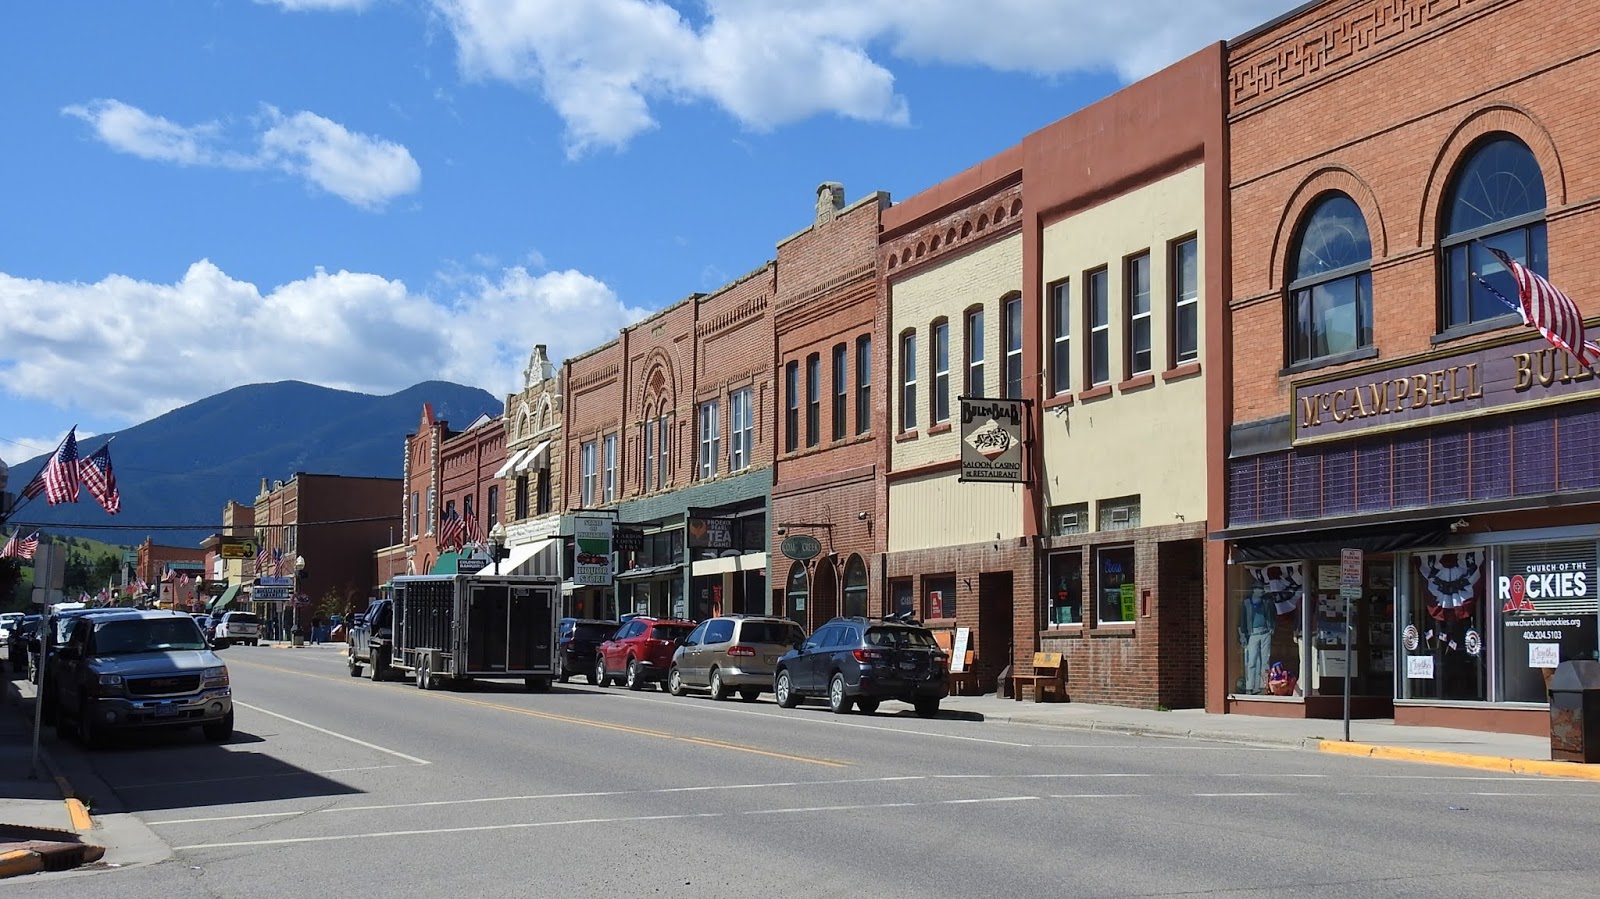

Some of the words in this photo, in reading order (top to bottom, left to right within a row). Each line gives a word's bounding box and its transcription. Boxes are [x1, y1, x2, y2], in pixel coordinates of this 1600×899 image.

[994, 461, 1021, 470] CASINO
[973, 470, 1018, 479] RESTAURANT
[707, 530, 732, 542] TEA
[577, 566, 608, 575] LIQUOR
[1526, 563, 1556, 573] CHURCH
[1559, 562, 1569, 571] OF
[1572, 562, 1587, 570] THE
[580, 575, 605, 583] STORE
[1504, 618, 1581, 628] www.churchoftherockies.org
[1522, 631, 1562, 640] 406.204.5103
